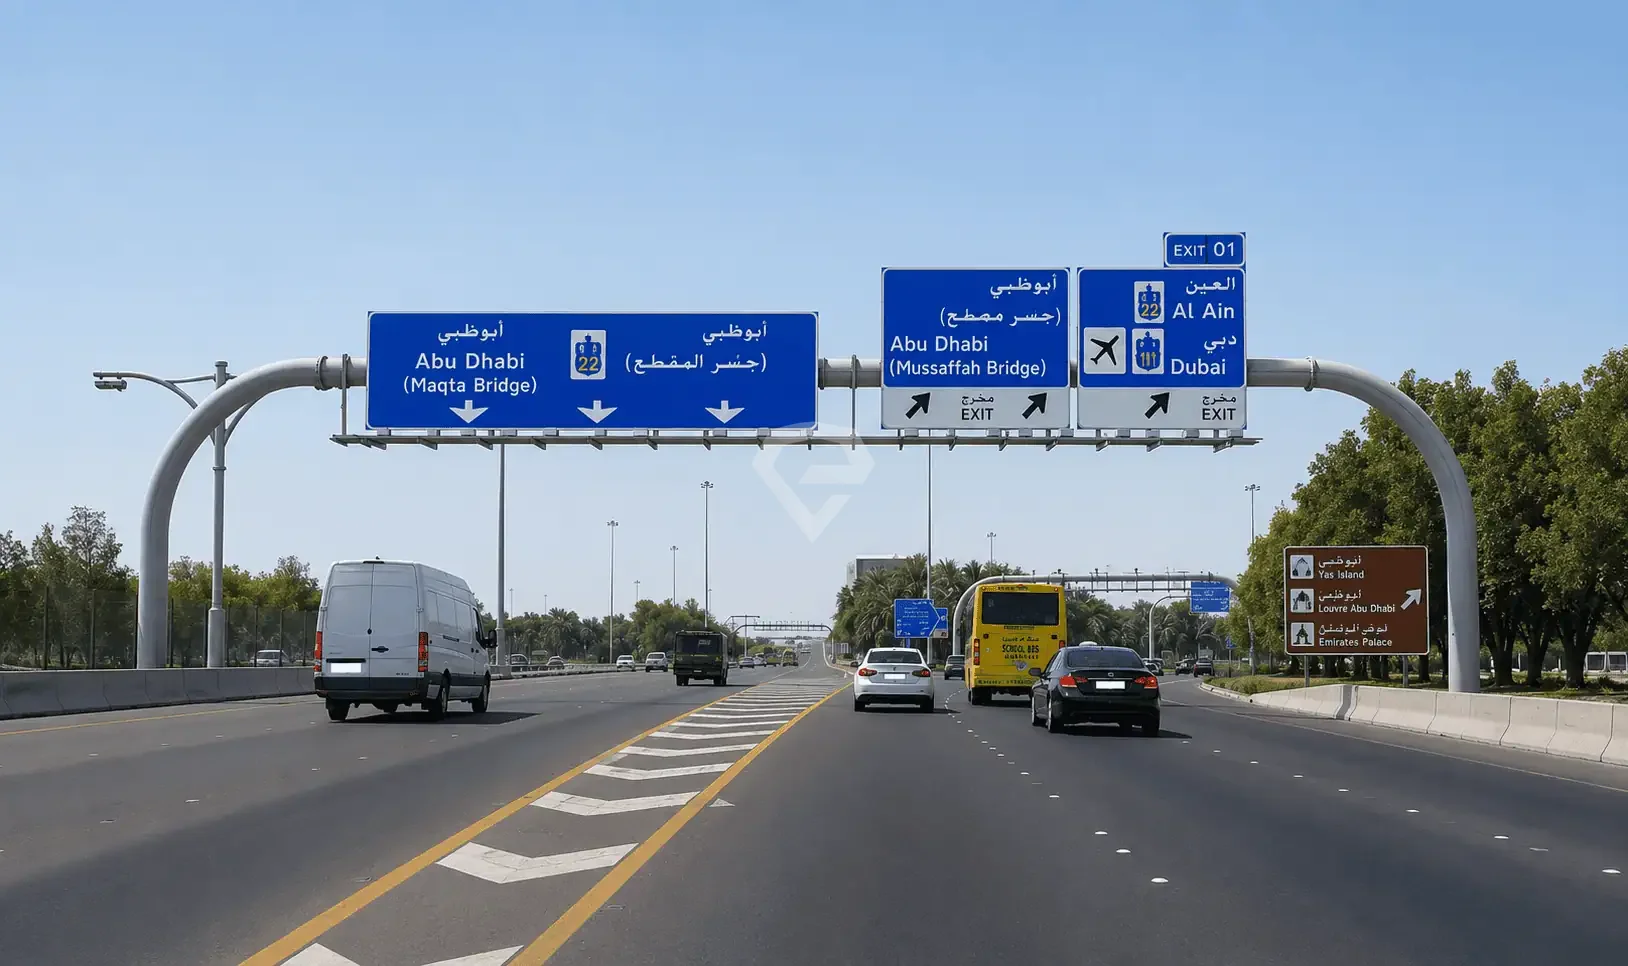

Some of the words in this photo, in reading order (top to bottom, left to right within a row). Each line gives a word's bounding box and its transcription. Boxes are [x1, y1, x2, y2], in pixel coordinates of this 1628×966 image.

[1174, 244, 1206, 257] EXIT
[1213, 242, 1235, 257] 01
[990, 273, 1057, 299] أبوظبي
[1186, 277, 1236, 298] العين
[1141, 303, 1159, 317] 22
[1172, 302, 1195, 319] Al
[1201, 302, 1235, 319] Ain
[437, 319, 503, 345] أبوظبي
[702, 320, 767, 346] أبوظبي
[890, 335, 928, 352] Abu
[936, 335, 988, 352] Dhabi
[1203, 335, 1237, 354] دبي
[414, 352, 456, 370] Abu
[466, 352, 525, 370] Dhabi
[578, 356, 599, 371] 22
[889, 358, 981, 378] (Mussaffah
[987, 358, 1047, 379] Bridge)
[1171, 358, 1227, 375] Dubai
[403, 375, 466, 396] (Maqta
[474, 375, 537, 396] Bridge)
[961, 393, 995, 406] مخرج
[1202, 393, 1237, 406] مخرج
[961, 407, 994, 421] EXIT
[1202, 407, 1237, 421] EXIT
[1318, 570, 1334, 579] Yas
[1337, 570, 1365, 579] Island
[1318, 604, 1348, 613] Louvre
[1350, 604, 1368, 613] Abu
[1370, 604, 1396, 613] Dhabi
[1319, 637, 1359, 647] Emirates
[1362, 637, 1393, 647] Palace
